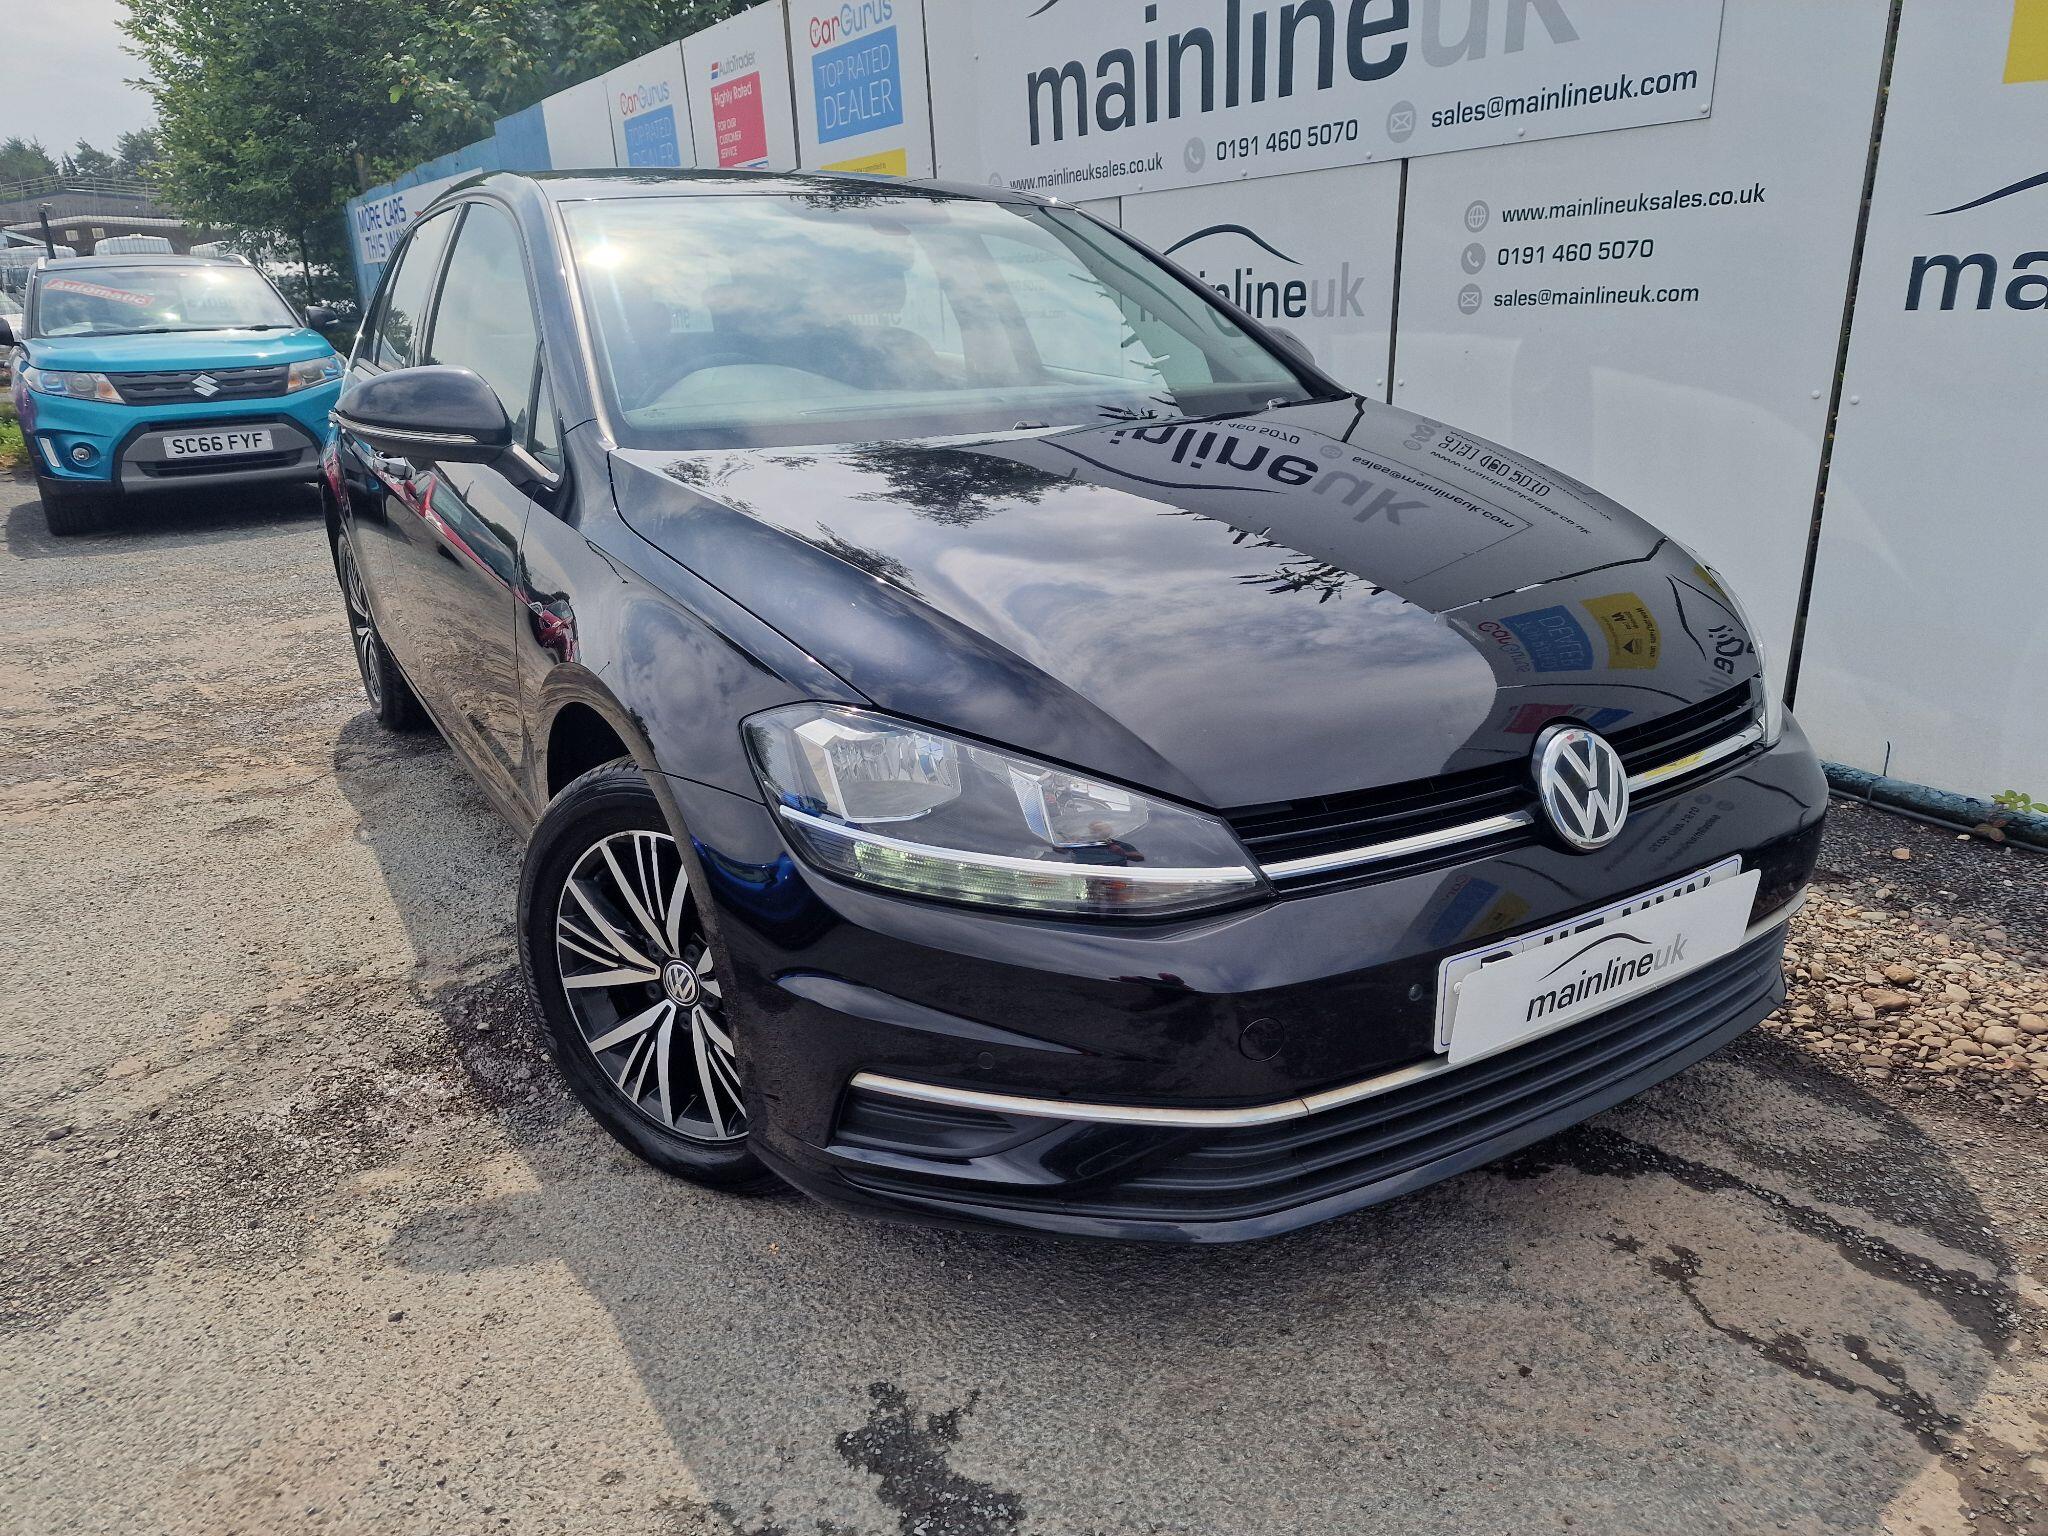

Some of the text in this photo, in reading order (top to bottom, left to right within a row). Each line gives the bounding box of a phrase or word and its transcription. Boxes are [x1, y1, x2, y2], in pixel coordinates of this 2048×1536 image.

[810, 0, 892, 48] CarGurus
[819, 44, 891, 89] TOP RATED
[823, 78, 895, 130] DEALER
[1216, 136, 1259, 160] 0191
[1265, 128, 1301, 152] 460
[1307, 119, 1358, 147] 5070
[1431, 70, 1698, 128] sales@mainlineuk.com
[357, 195, 407, 233] MORE CARS
[1501, 182, 1767, 223] www.mainlineuksales.co.uk
[365, 233, 386, 259] THIS
[1497, 238, 1655, 266] 0191 460 5070
[49, 279, 148, 306] Automatic
[1493, 284, 1700, 307] sales@mainlineuk.com
[172, 432, 263, 455] SC66 FYF
[1525, 933, 1688, 1023] mainlineuk
